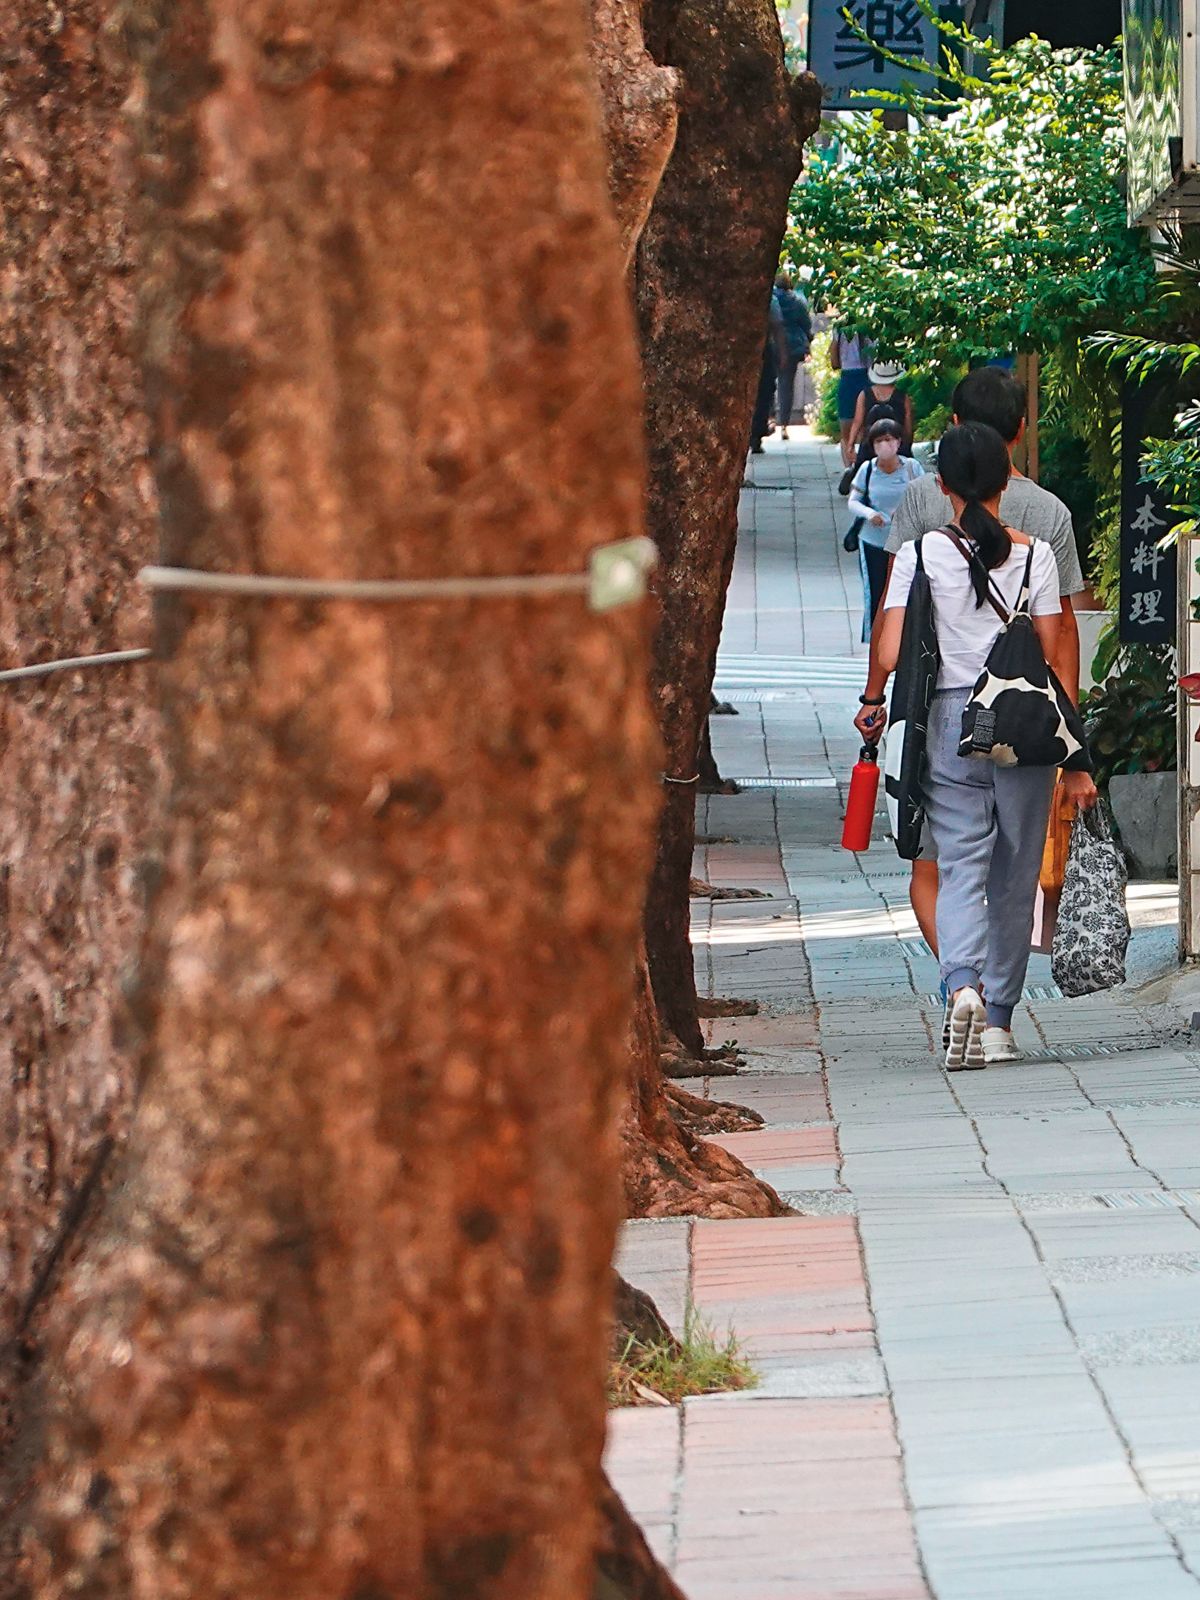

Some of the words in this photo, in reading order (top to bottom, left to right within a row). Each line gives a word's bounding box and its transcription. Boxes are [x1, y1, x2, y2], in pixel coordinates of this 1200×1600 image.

[833, 0, 926, 73] 樂
[1128, 456, 1168, 625] 本料理
